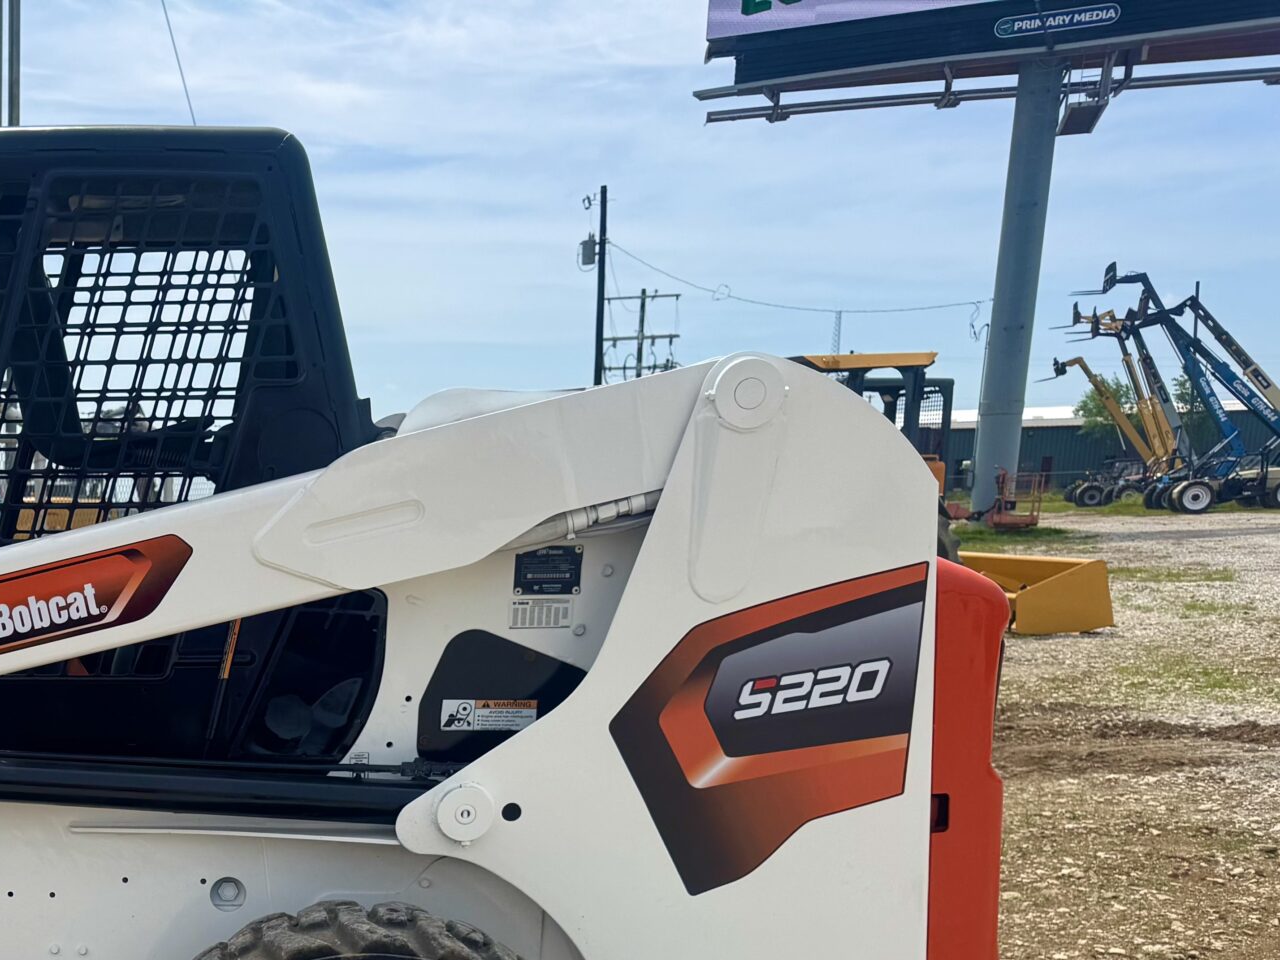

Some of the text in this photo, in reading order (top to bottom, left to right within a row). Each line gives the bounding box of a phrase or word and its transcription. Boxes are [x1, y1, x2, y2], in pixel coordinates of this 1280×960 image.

[1073, 8, 1116, 23] MEDIA
[733, 658, 892, 720] S220
[493, 700, 532, 708] WARNING
